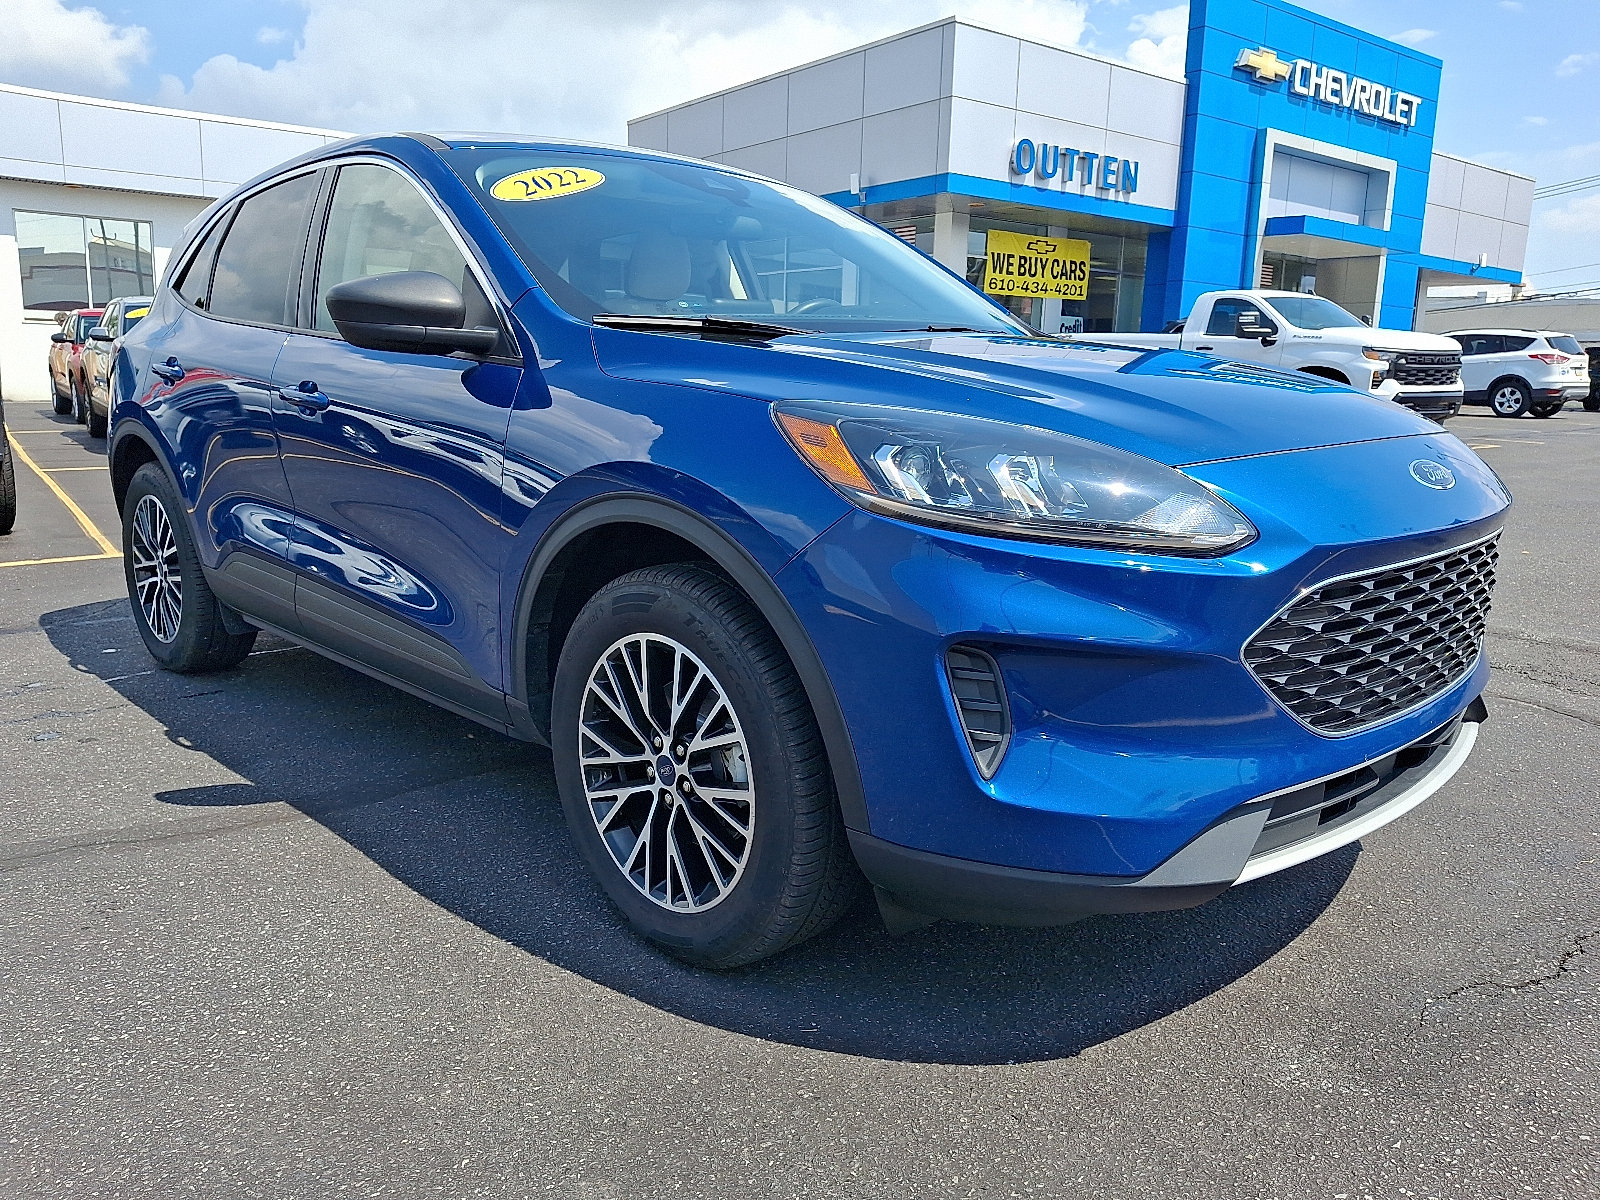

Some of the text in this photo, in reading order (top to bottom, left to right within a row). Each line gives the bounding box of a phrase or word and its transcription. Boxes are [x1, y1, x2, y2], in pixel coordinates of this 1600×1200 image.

[1292, 58, 1422, 127] CHEVROLET
[1013, 138, 1139, 193] OUTTEN
[514, 169, 587, 197] 2022
[990, 252, 1087, 282] WE BUY CARS
[988, 277, 1085, 297] 610-434-4201
[1407, 355, 1460, 364] CHEVROLE
